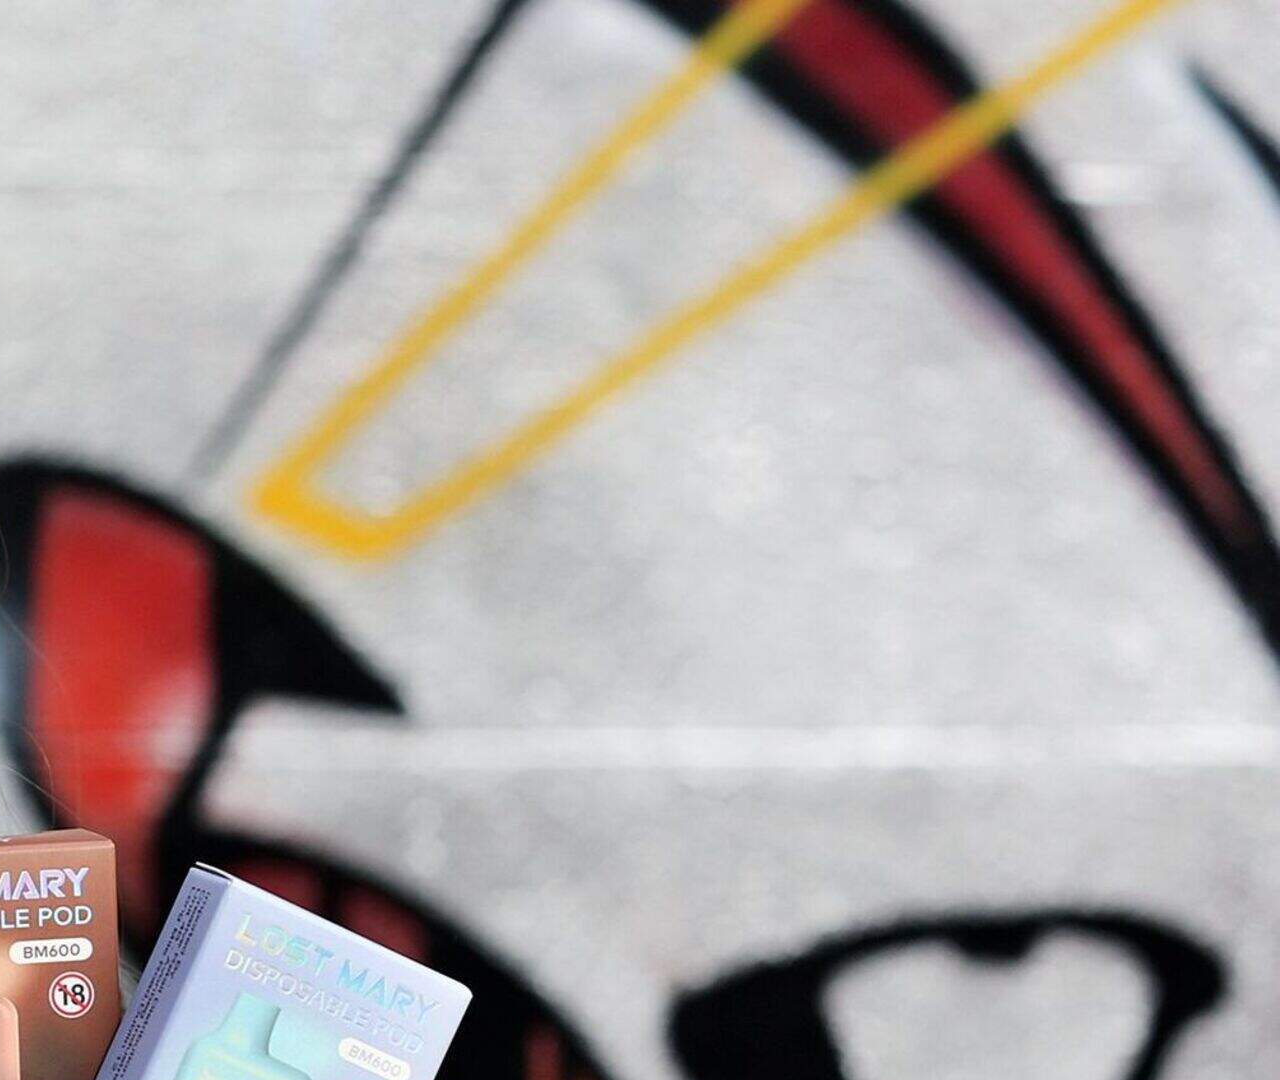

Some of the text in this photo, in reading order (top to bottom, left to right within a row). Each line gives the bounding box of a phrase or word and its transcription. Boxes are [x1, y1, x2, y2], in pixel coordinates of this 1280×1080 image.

[37, 905, 93, 928] POD
[22, 944, 82, 960] BM600
[233, 912, 335, 976] LOST
[335, 957, 440, 1024] MARY
[224, 947, 371, 1031] DISPOSABLE
[369, 1020, 425, 1056] POD
[347, 1044, 403, 1079] BM600
